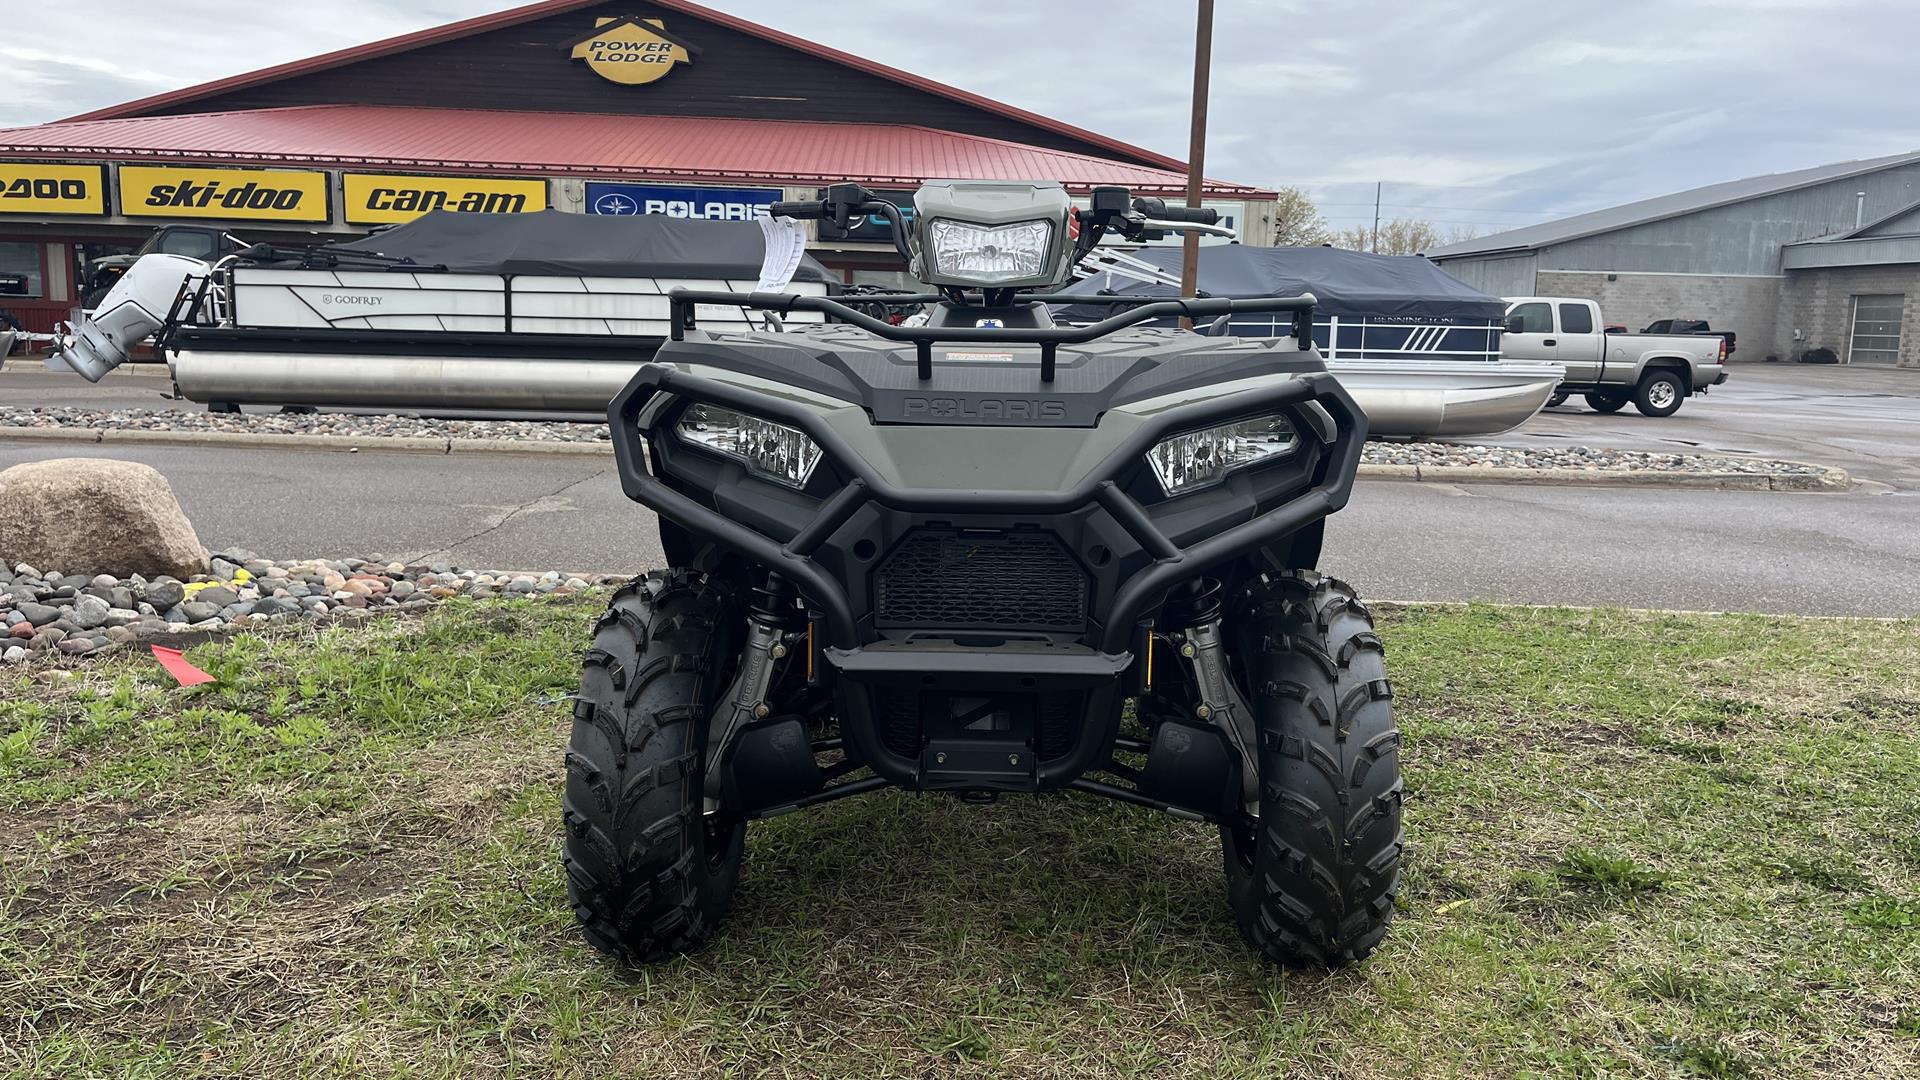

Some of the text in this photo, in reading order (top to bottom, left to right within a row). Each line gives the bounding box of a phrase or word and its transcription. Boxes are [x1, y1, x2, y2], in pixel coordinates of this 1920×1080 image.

[589, 41, 672, 52] POWER
[594, 51, 669, 63] LODGE
[145, 181, 304, 210] ski-doo
[366, 188, 526, 213] can-am
[335, 296, 382, 305] GODFREY
[903, 398, 1067, 420] POLARIS
